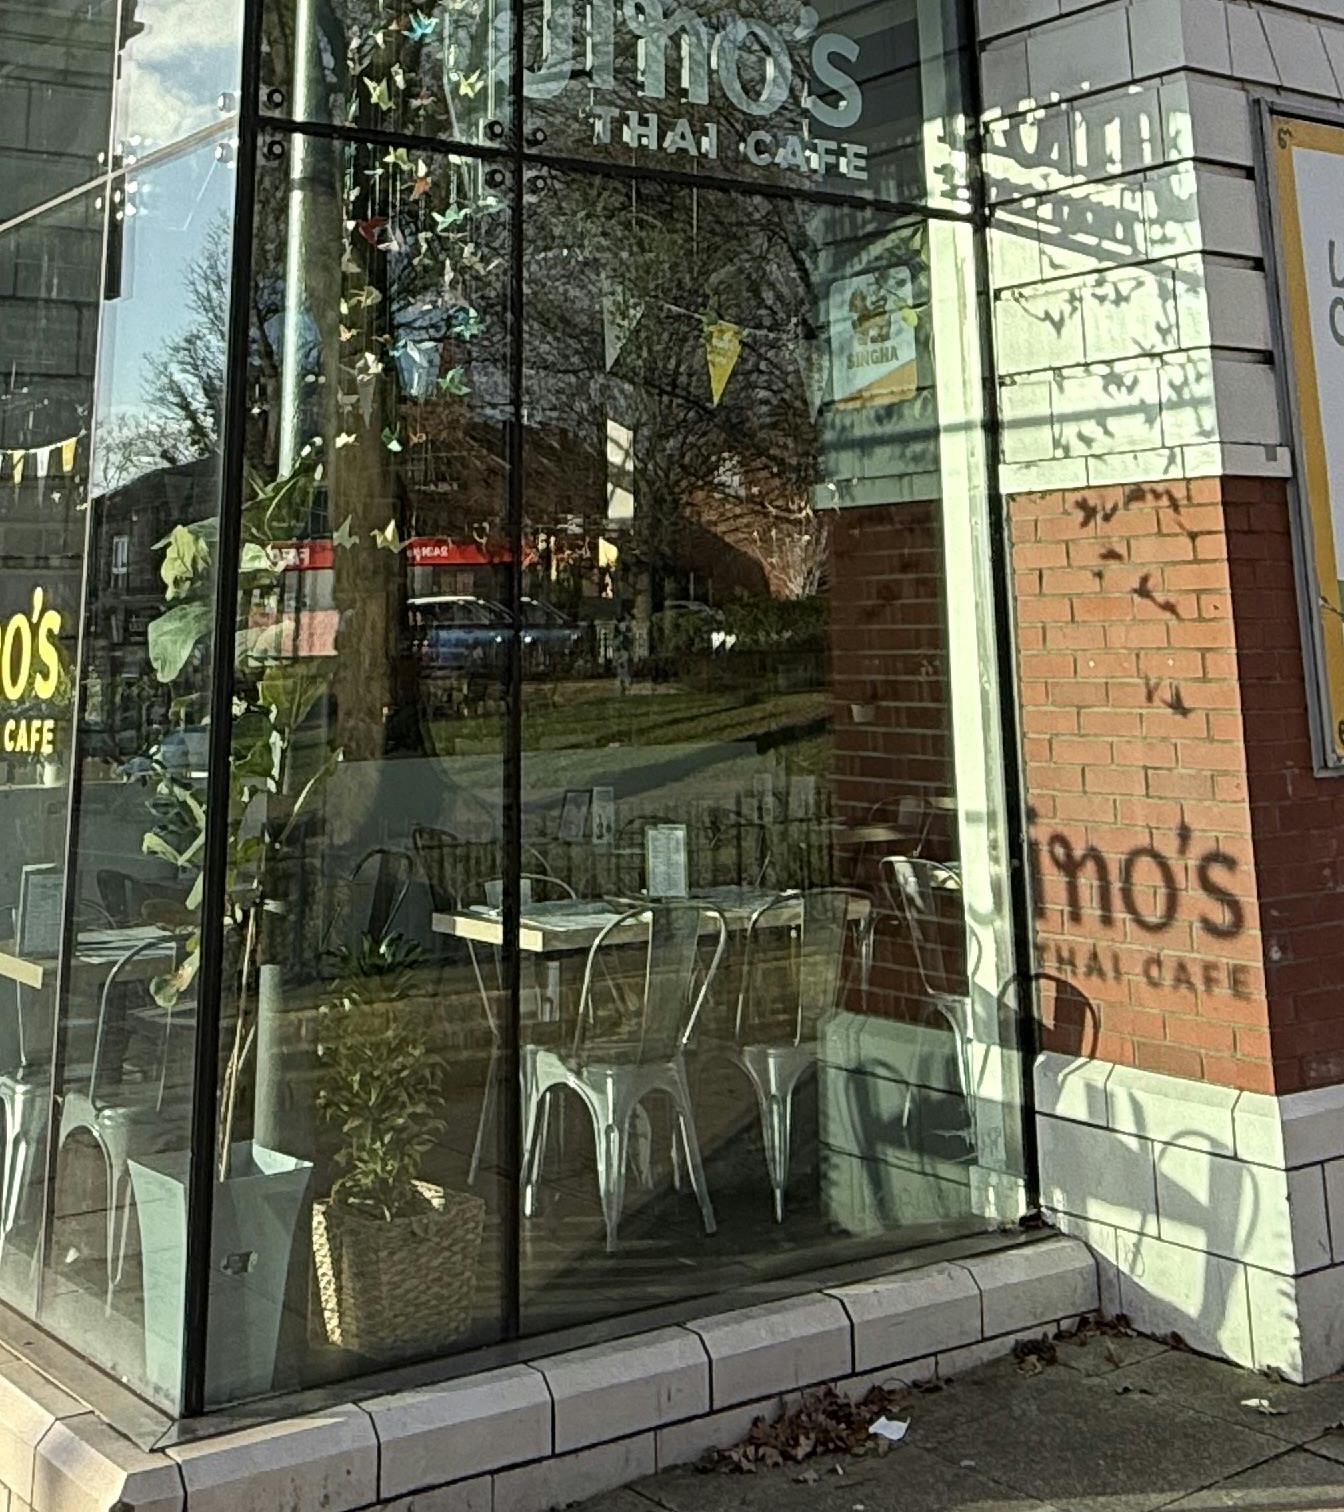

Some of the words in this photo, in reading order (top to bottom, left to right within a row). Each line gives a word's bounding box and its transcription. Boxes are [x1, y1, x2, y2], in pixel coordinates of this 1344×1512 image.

[593, 105, 718, 159] THAI
[745, 130, 869, 180] CAFE
[847, 345, 899, 369] SINGHA
[4, 718, 55, 754] CAFE
[1142, 955, 1254, 1000] CAFE
